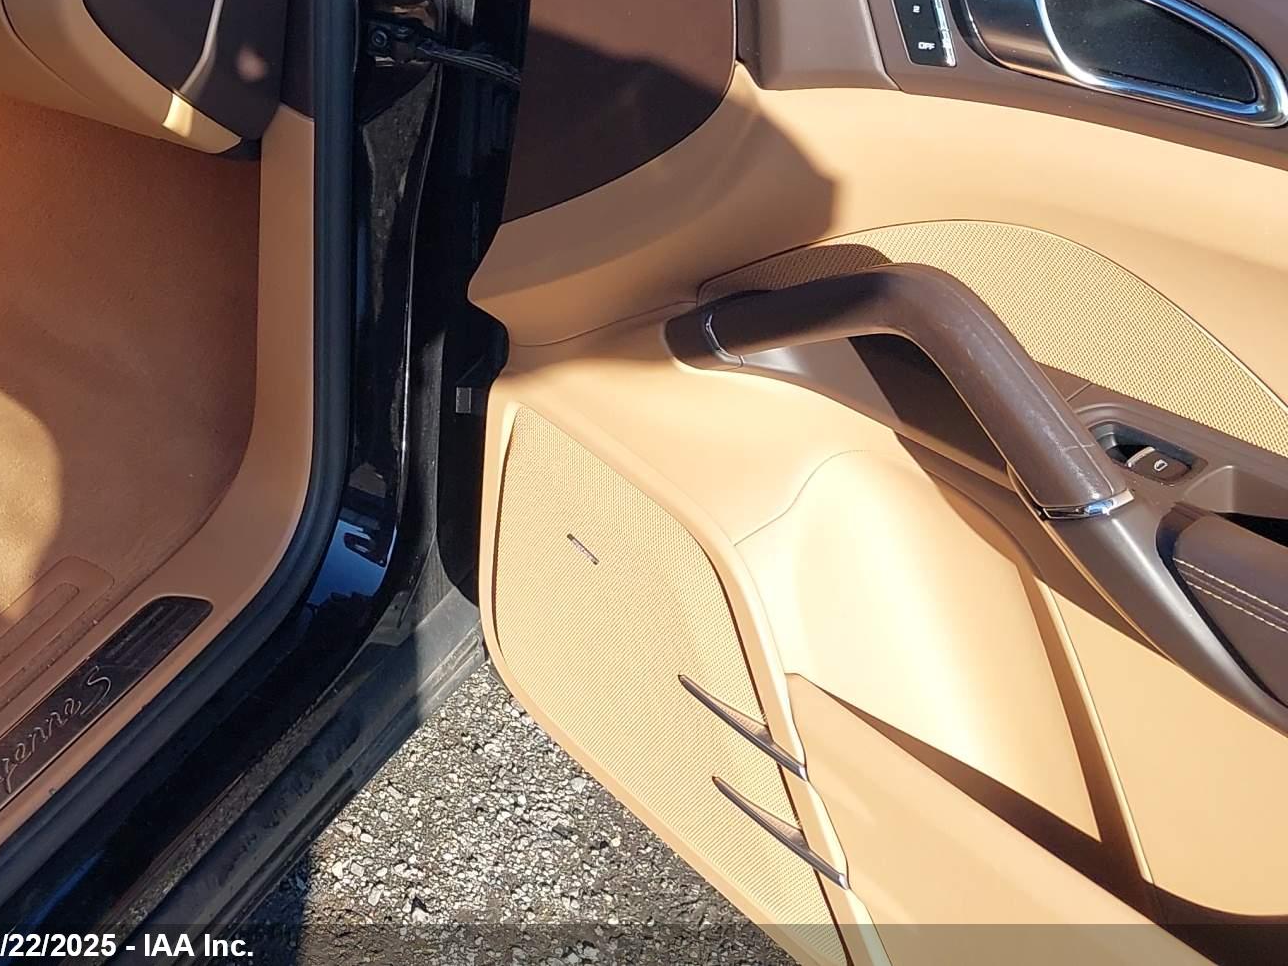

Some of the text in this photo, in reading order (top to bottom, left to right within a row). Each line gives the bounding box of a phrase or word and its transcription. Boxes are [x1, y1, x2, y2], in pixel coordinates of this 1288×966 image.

[913, 5, 920, 13] 2
[918, 41, 935, 50] OFF
[79, 665, 112, 716] S
